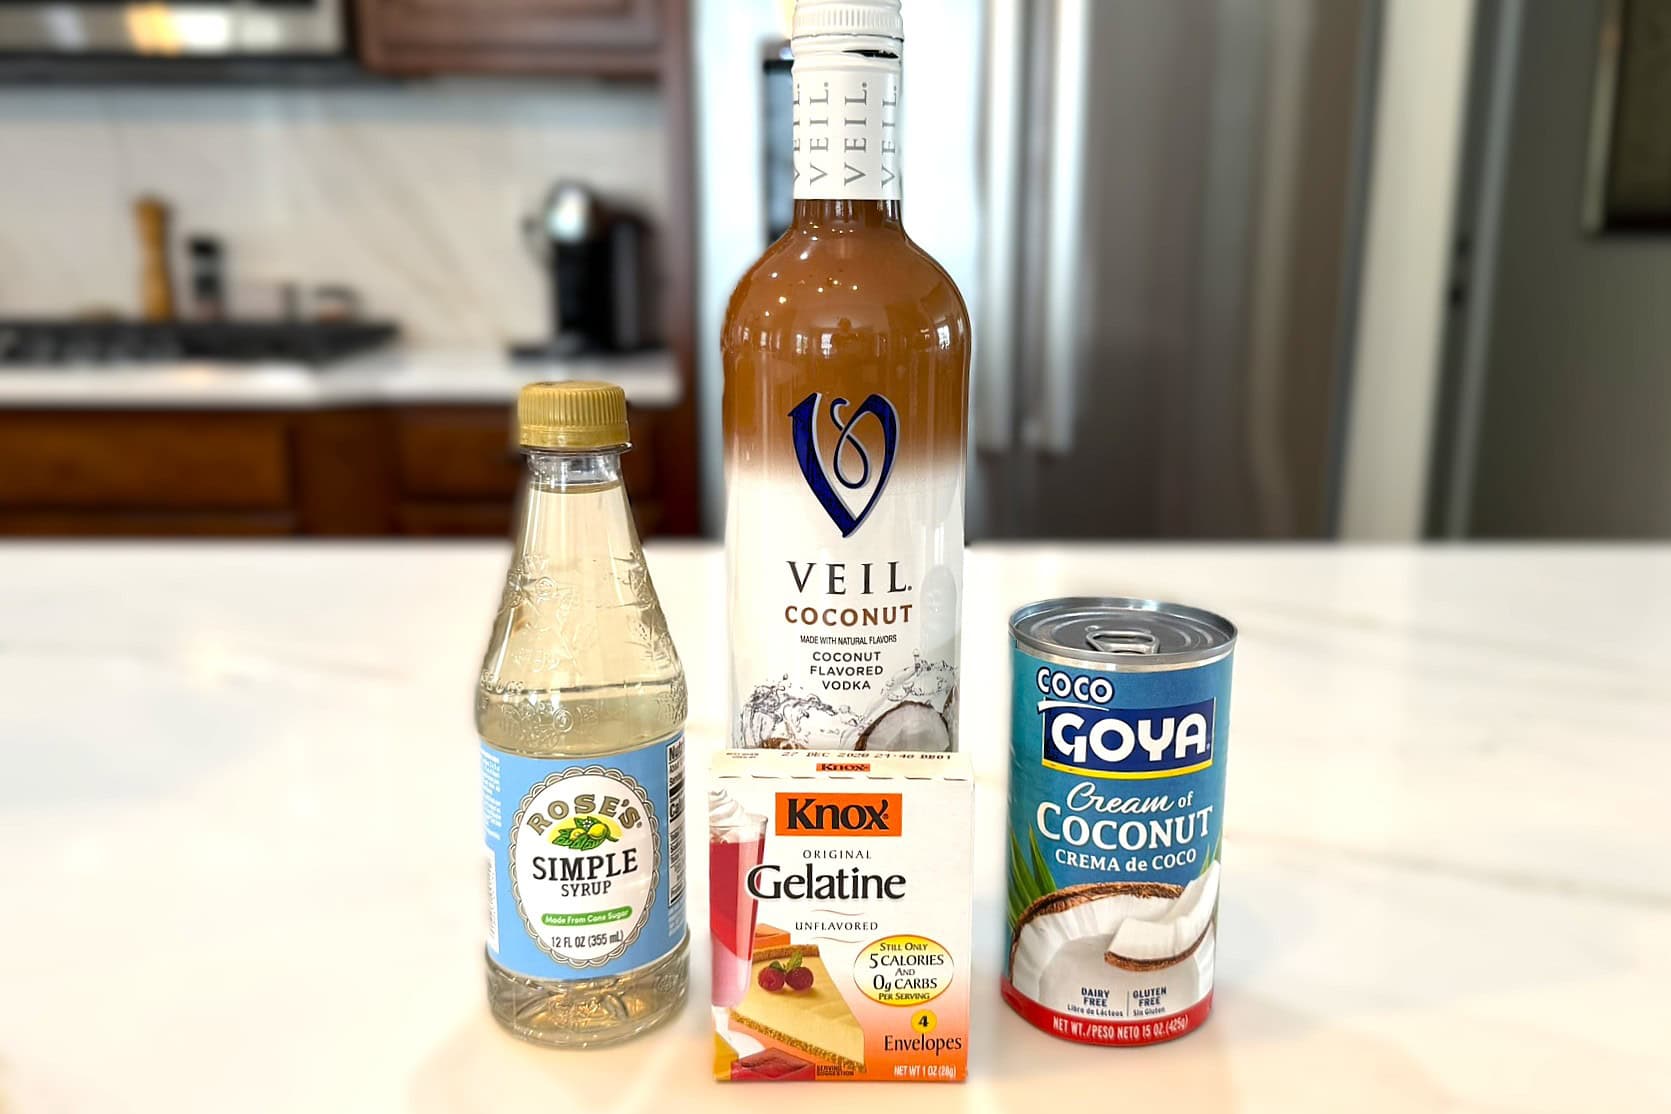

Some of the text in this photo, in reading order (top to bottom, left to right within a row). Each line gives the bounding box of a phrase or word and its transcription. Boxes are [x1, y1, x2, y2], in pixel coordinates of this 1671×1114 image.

[785, 604, 913, 627] COCONUT
[800, 634, 898, 646] MADE WITH NATURAL FLAVORS
[812, 651, 881, 662] COCONUT
[810, 665, 884, 677] FLAVORED
[821, 680, 871, 691] VODKA
[1037, 666, 1114, 704] COCO
[1051, 712, 1208, 763] GOYA
[1066, 781, 1194, 814] Cream of
[527, 794, 641, 836] ROSE'S
[787, 798, 889, 830] Knox
[1036, 802, 1214, 851] COCONUT
[802, 849, 871, 860] ORIGINAL
[1055, 849, 1197, 872] CREMA de COCO
[532, 848, 638, 881] SIMPLE
[561, 880, 612, 897] SYRUP
[747, 863, 907, 900] Gelatine
[545, 910, 629, 924] Made From Cane Sugar
[795, 921, 879, 931] UNFLAVORED
[552, 929, 624, 948] 12 FL OZ (355 mL)
[869, 953, 944, 969] 5 CALORIES
[873, 974, 938, 992] 0g CARBS
[1081, 987, 1110, 998] DAIRY
[1132, 986, 1167, 999] GLUTEN
[1067, 1004, 1084, 1014] Libre
[1083, 997, 1107, 1007] FREE
[1138, 996, 1161, 1007] FREE
[1144, 1006, 1165, 1016] Gluten
[918, 1015, 929, 1028] 4
[1053, 1016, 1068, 1030] NET
[1117, 1026, 1140, 1039] NETO
[1142, 1024, 1151, 1037] 15
[884, 1033, 962, 1056] Envelopes
[893, 1065, 907, 1076] NET
[909, 1065, 920, 1076] WT
[928, 1065, 938, 1076] OZ
